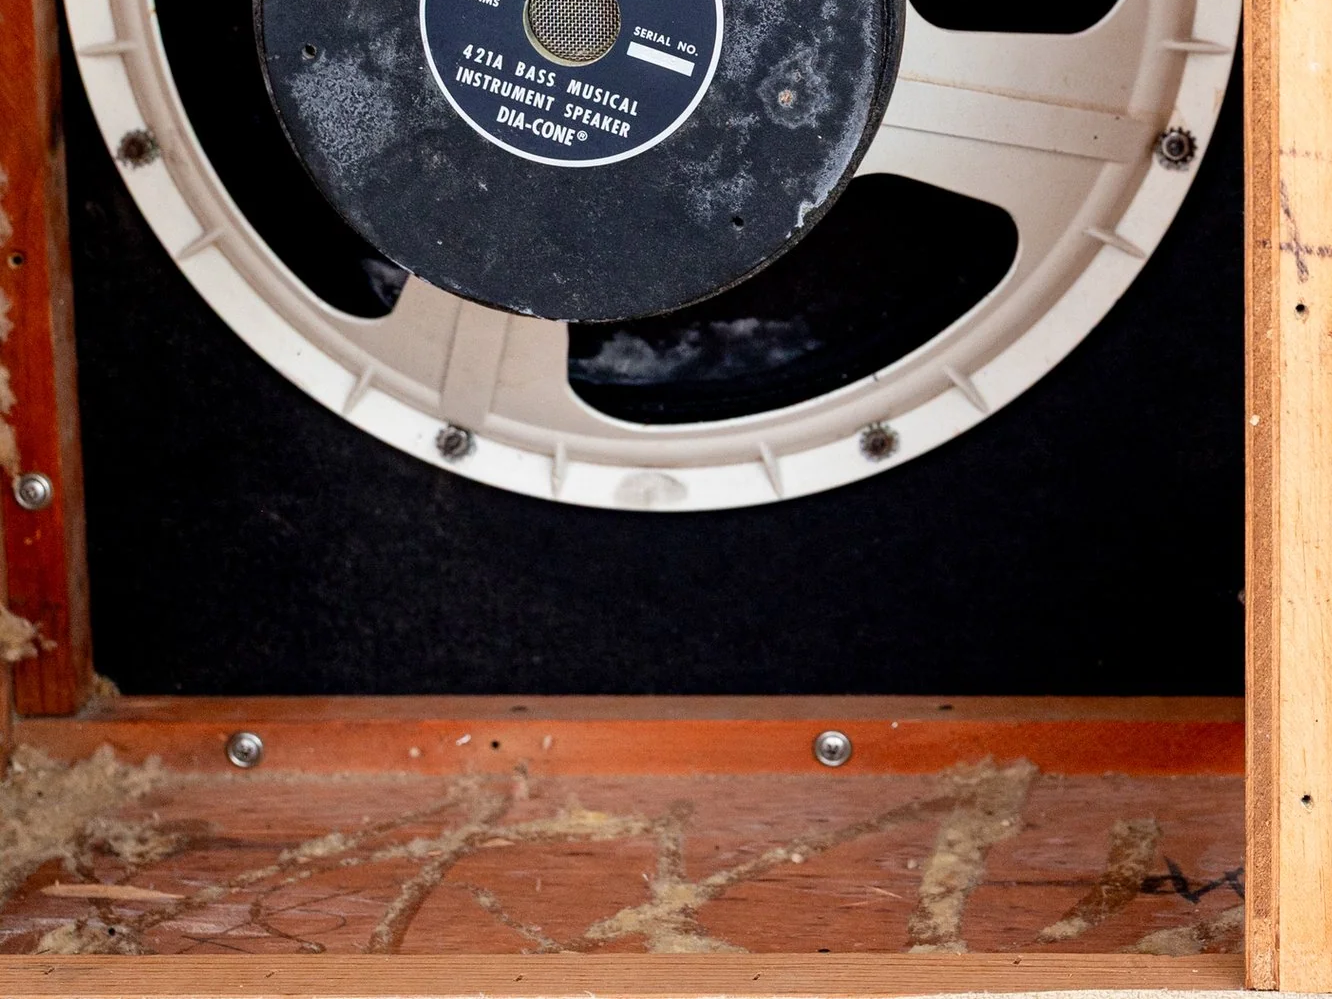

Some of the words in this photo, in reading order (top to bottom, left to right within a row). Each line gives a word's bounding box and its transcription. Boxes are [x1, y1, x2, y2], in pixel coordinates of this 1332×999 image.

[633, 26, 671, 46] SERIAL
[676, 40, 699, 56] NO.
[456, 67, 555, 111] INSTRUMENT
[564, 104, 630, 138] SPEAKER
[462, 44, 503, 70] 421A
[515, 61, 556, 87] BASS
[567, 79, 638, 116] MUSICAL
